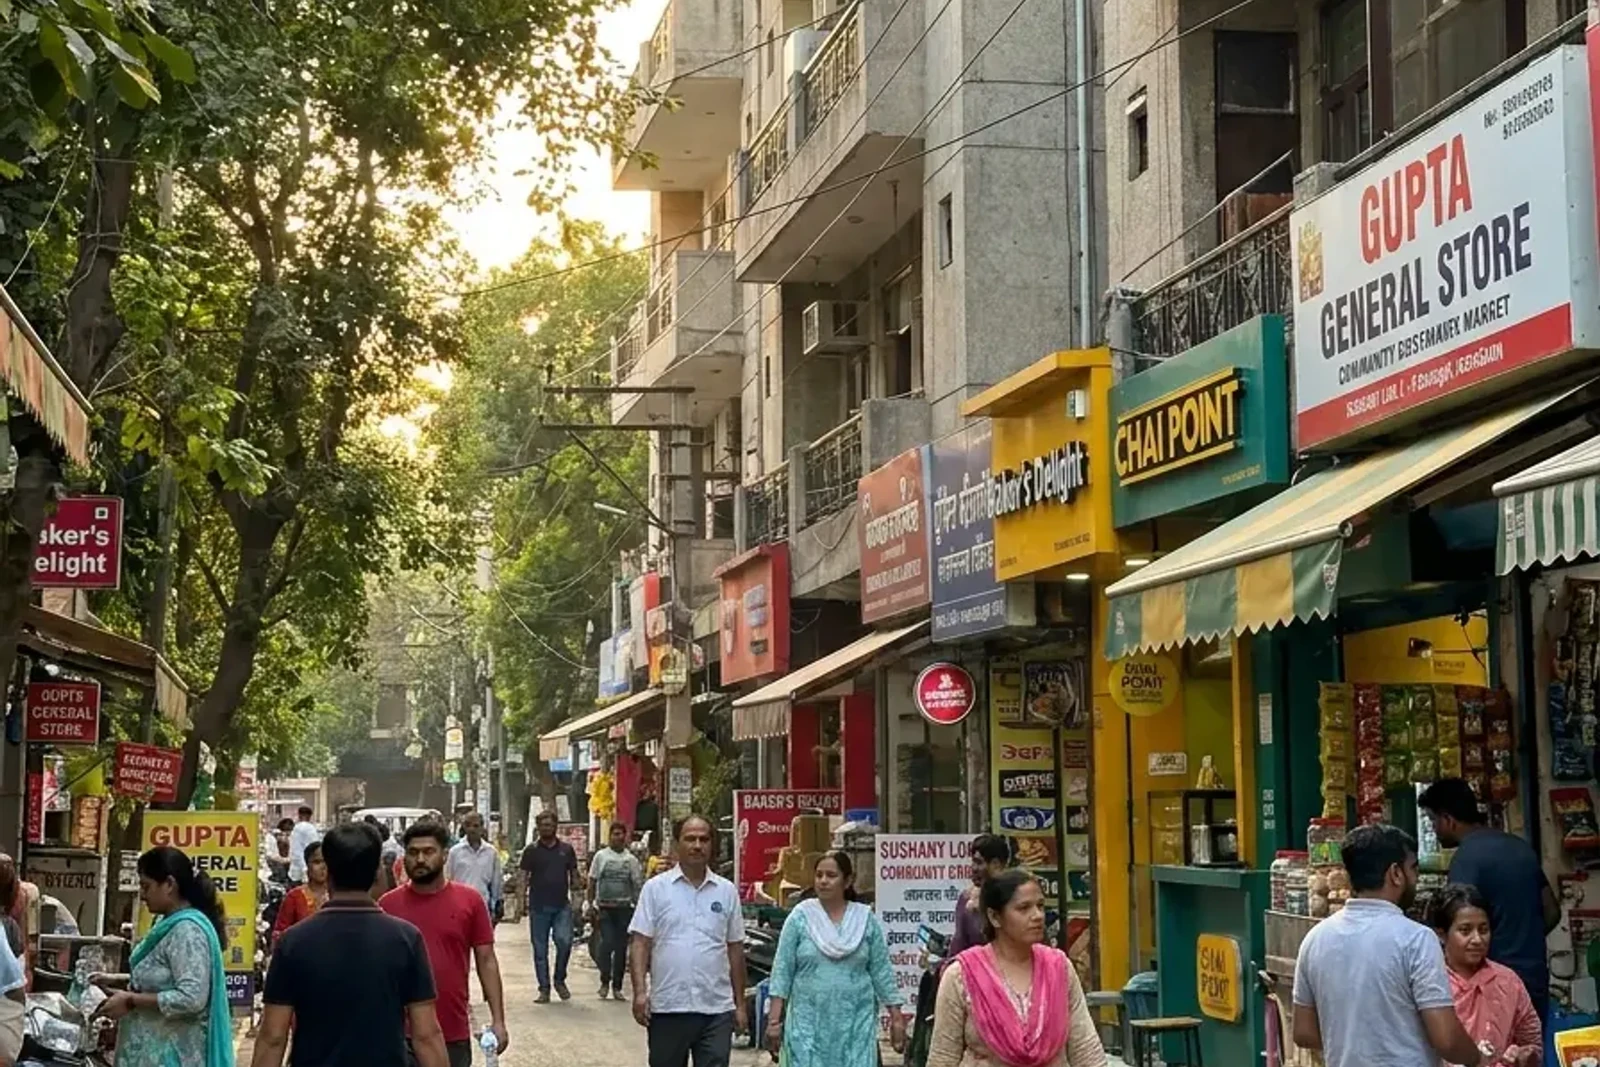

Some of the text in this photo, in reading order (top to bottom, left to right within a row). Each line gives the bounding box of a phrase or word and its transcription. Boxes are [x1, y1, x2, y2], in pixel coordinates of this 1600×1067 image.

[1360, 133, 1472, 262] GUPTA
[1320, 201, 1532, 360] GENERAL STORE
[1114, 379, 1239, 478] CHAI POINT
[1034, 441, 1084, 504] Delight
[34, 551, 108, 578] elight
[149, 825, 251, 848] GUPTA
[191, 855, 252, 871] ERAL
